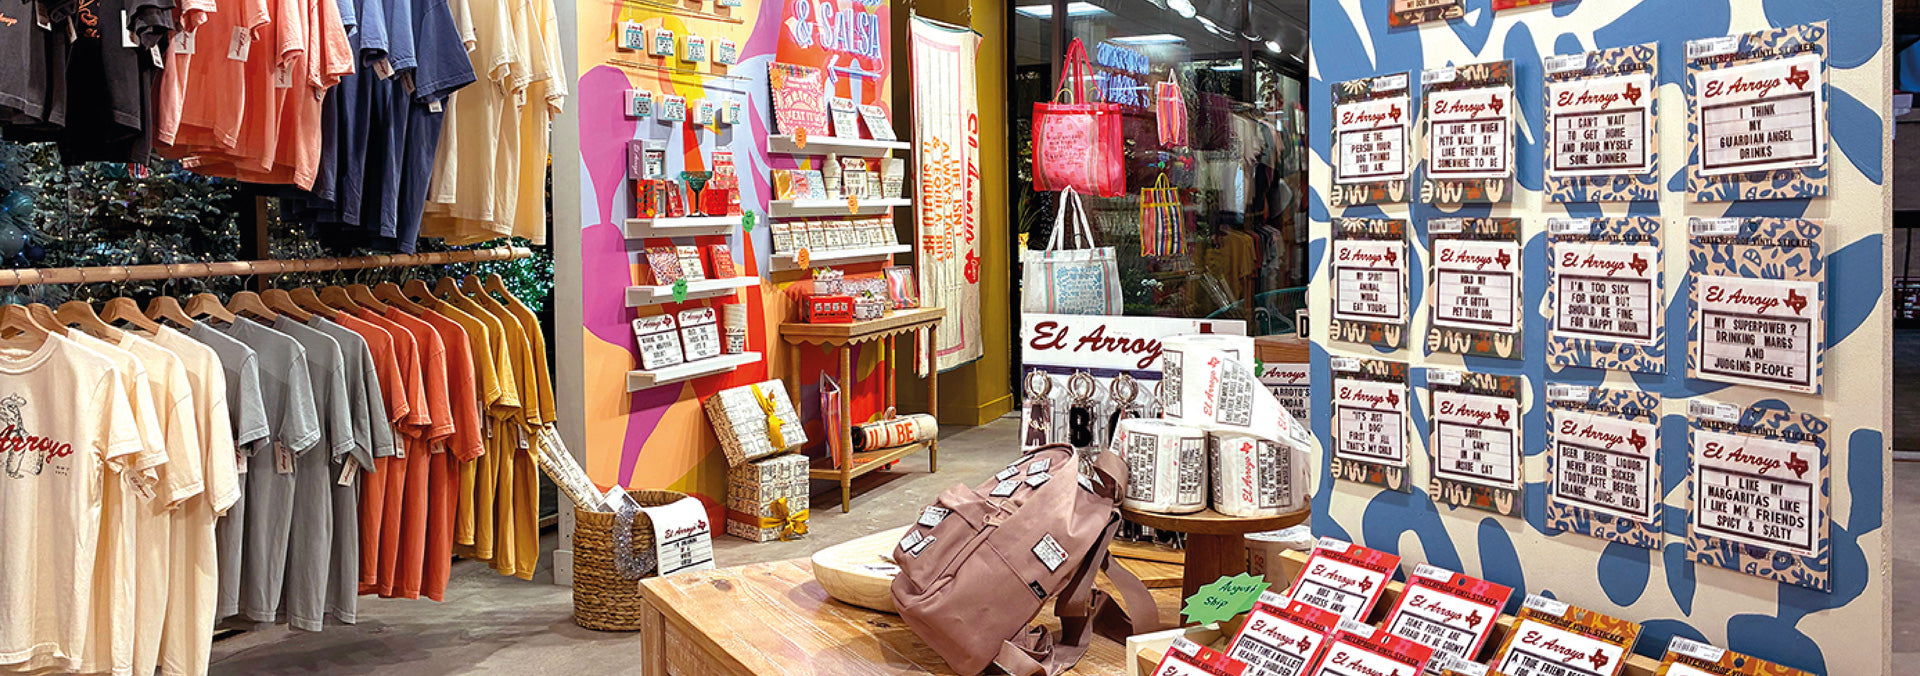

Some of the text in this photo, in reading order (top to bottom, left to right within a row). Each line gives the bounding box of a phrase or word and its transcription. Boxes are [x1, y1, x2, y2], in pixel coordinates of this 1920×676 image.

[820, 2, 880, 59] SALSA
[1704, 77, 1781, 98] El Arroyo
[1434, 99, 1486, 118] El Arroyo
[1557, 90, 1619, 110] El Arroyo
[1342, 111, 1386, 127] El Arroyo
[1740, 104, 1775, 119] I THINK
[1441, 123, 1499, 135] I LOVE IT WHEN
[1569, 115, 1625, 128] I CAN'T WAIT
[1749, 120, 1762, 131] MY
[1439, 135, 1491, 145] PETS WALK BY
[1568, 127, 1625, 141] TO GET HOME
[1720, 130, 1793, 148] GUARDIAN ANGEL
[1442, 146, 1496, 156] LIKE THEY HAVE
[1562, 139, 1632, 153] AND POUR MYSELF
[1739, 146, 1772, 159] DRINKS
[1438, 157, 1498, 168] SOMEWHERE TO BE
[1569, 153, 1626, 164] SOME DINNER
[950, 159, 961, 191] LIFE
[942, 142, 954, 260] ALWAYS TACOS
[1339, 248, 1382, 267] El Arroyo
[1440, 249, 1492, 270] El Arroyo
[1561, 253, 1625, 278] El Arroyo
[1571, 281, 1629, 295] I'M TOO SICK
[1572, 293, 1630, 307] FOR WORK BUT
[1706, 286, 1779, 315] El Arroyo
[1568, 306, 1633, 319] SHOULD BE FINE
[1571, 317, 1638, 333] FOR HAPPY HOUR
[1714, 317, 1797, 335] MY SUPERPOWER ?
[1030, 321, 1164, 369] El Arroy
[1715, 333, 1793, 349] DRINKING MARGS
[1744, 348, 1764, 360] AND
[1263, 367, 1306, 383] Arroyo
[1714, 360, 1793, 377] JUDGING PEOPLE
[1339, 387, 1384, 408] El Arroyo
[1440, 401, 1492, 425] El Arroyo
[895, 422, 914, 445] BE
[1350, 432, 1389, 444] FIRST OF ALL
[1560, 420, 1624, 449] El Arroyo
[0, 425, 73, 464] Arroyo
[1346, 441, 1392, 455] THAT'S MY CHILD
[1461, 438, 1490, 451] I CAN'T
[1562, 447, 1578, 459] BEER
[1584, 450, 1607, 465] BEFORE
[1703, 442, 1780, 475] El Arroyo
[1455, 460, 1493, 475] INSIDE CAT
[1566, 460, 1635, 482] NEVER BEEN SICKER
[1564, 471, 1637, 495] TOOTHPASTE BEFORE
[1726, 475, 1783, 495] I LIKE MY
[1560, 483, 1586, 498] ORANGE
[1622, 496, 1640, 509] DEAD
[1707, 485, 1800, 513] MARGARITAS LIKE
[1703, 498, 1805, 529] I LIKE MY FRIENDS
[665, 529, 673, 539] El
[1717, 515, 1792, 541] SPICY & SALTY
[1312, 564, 1356, 588] El Arroyo
[1219, 581, 1258, 595] August
[1204, 596, 1228, 609] Ship
[1409, 595, 1462, 623] El Arroyo
[1251, 620, 1294, 647] El Arroyo
[1522, 631, 1585, 663] El Arroyo
[1511, 653, 1518, 663] A
[1522, 656, 1539, 669] TRUE
